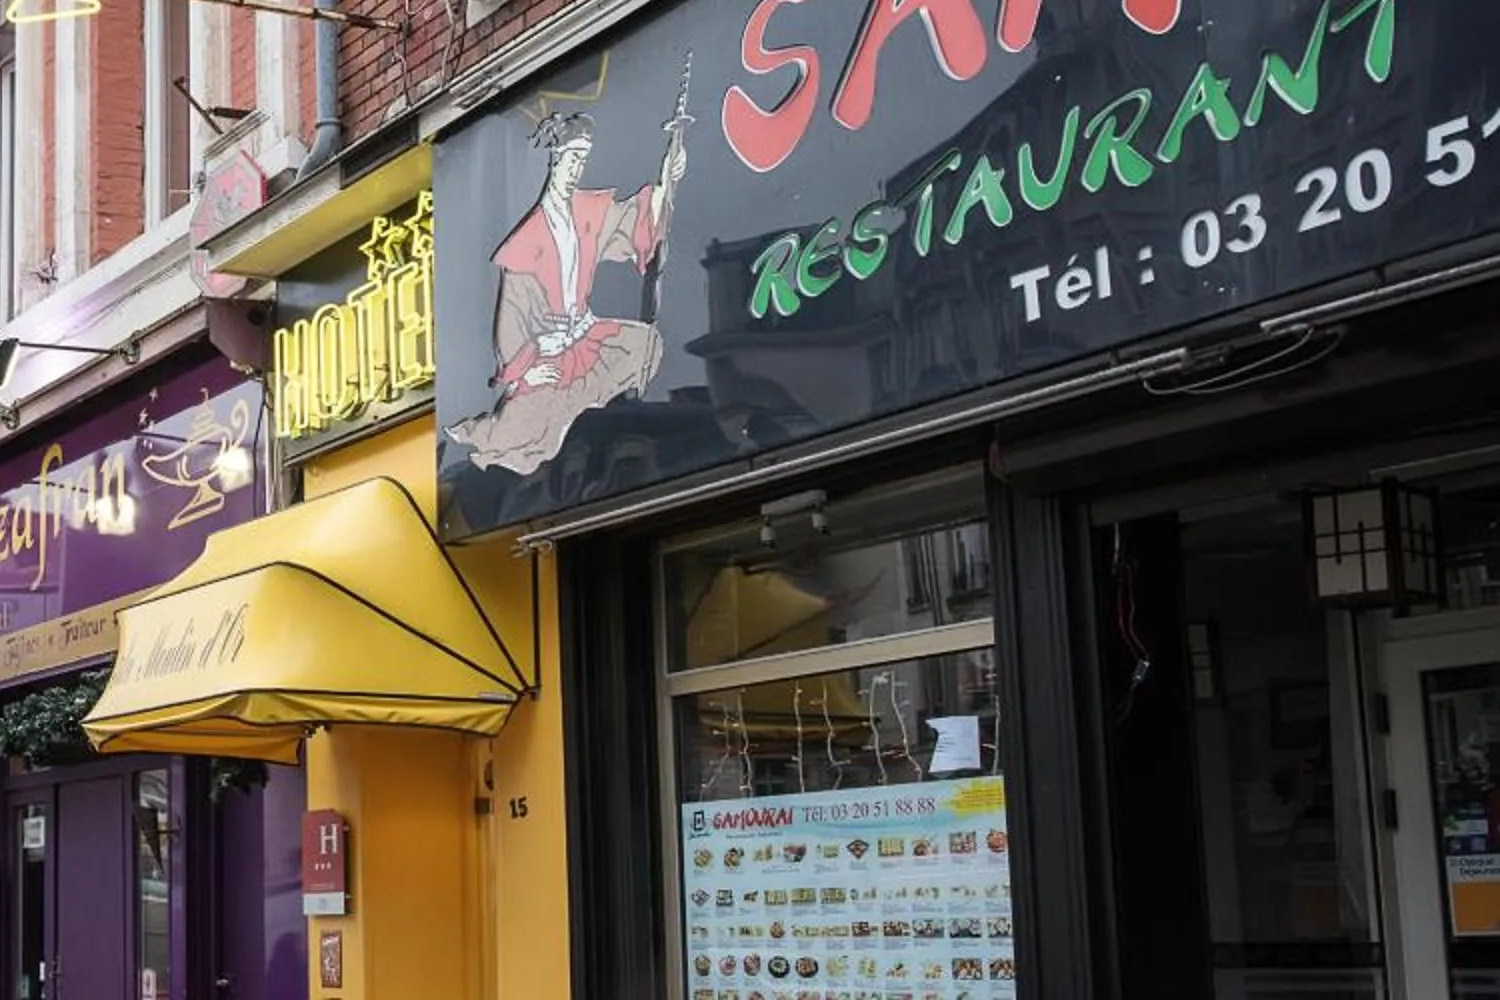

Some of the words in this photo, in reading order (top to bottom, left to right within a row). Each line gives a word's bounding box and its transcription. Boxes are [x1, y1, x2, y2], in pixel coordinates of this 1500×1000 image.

[1180, 193, 1268, 269] 03
[1294, 148, 1392, 233] 20
[1424, 105, 1500, 187] 5
[508, 797, 528, 820] 15
[712, 806, 793, 829] SAMOURAI
[831, 803, 850, 820] 03
[852, 802, 869, 819] 20
[873, 801, 889, 817] 51
[896, 797, 913, 816] 88
[918, 797, 936, 815] 88
[319, 823, 338, 855] H
